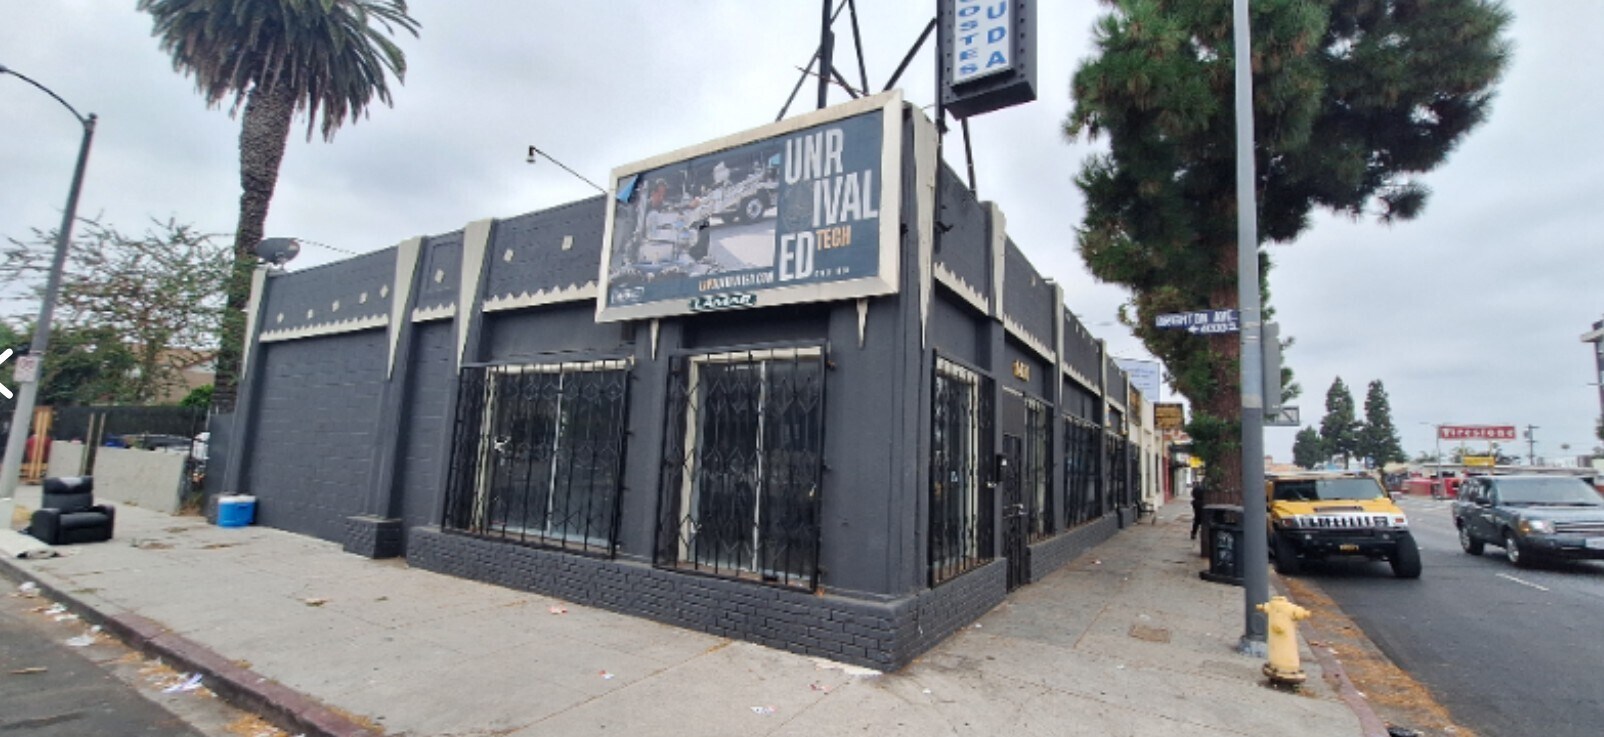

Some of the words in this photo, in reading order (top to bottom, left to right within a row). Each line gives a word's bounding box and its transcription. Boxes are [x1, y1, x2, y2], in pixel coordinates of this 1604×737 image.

[784, 128, 844, 185] UNR
[812, 169, 879, 228] IVAL
[778, 231, 815, 281] ED
[816, 225, 852, 250] TECH
[1441, 428, 1515, 438] Firestone
